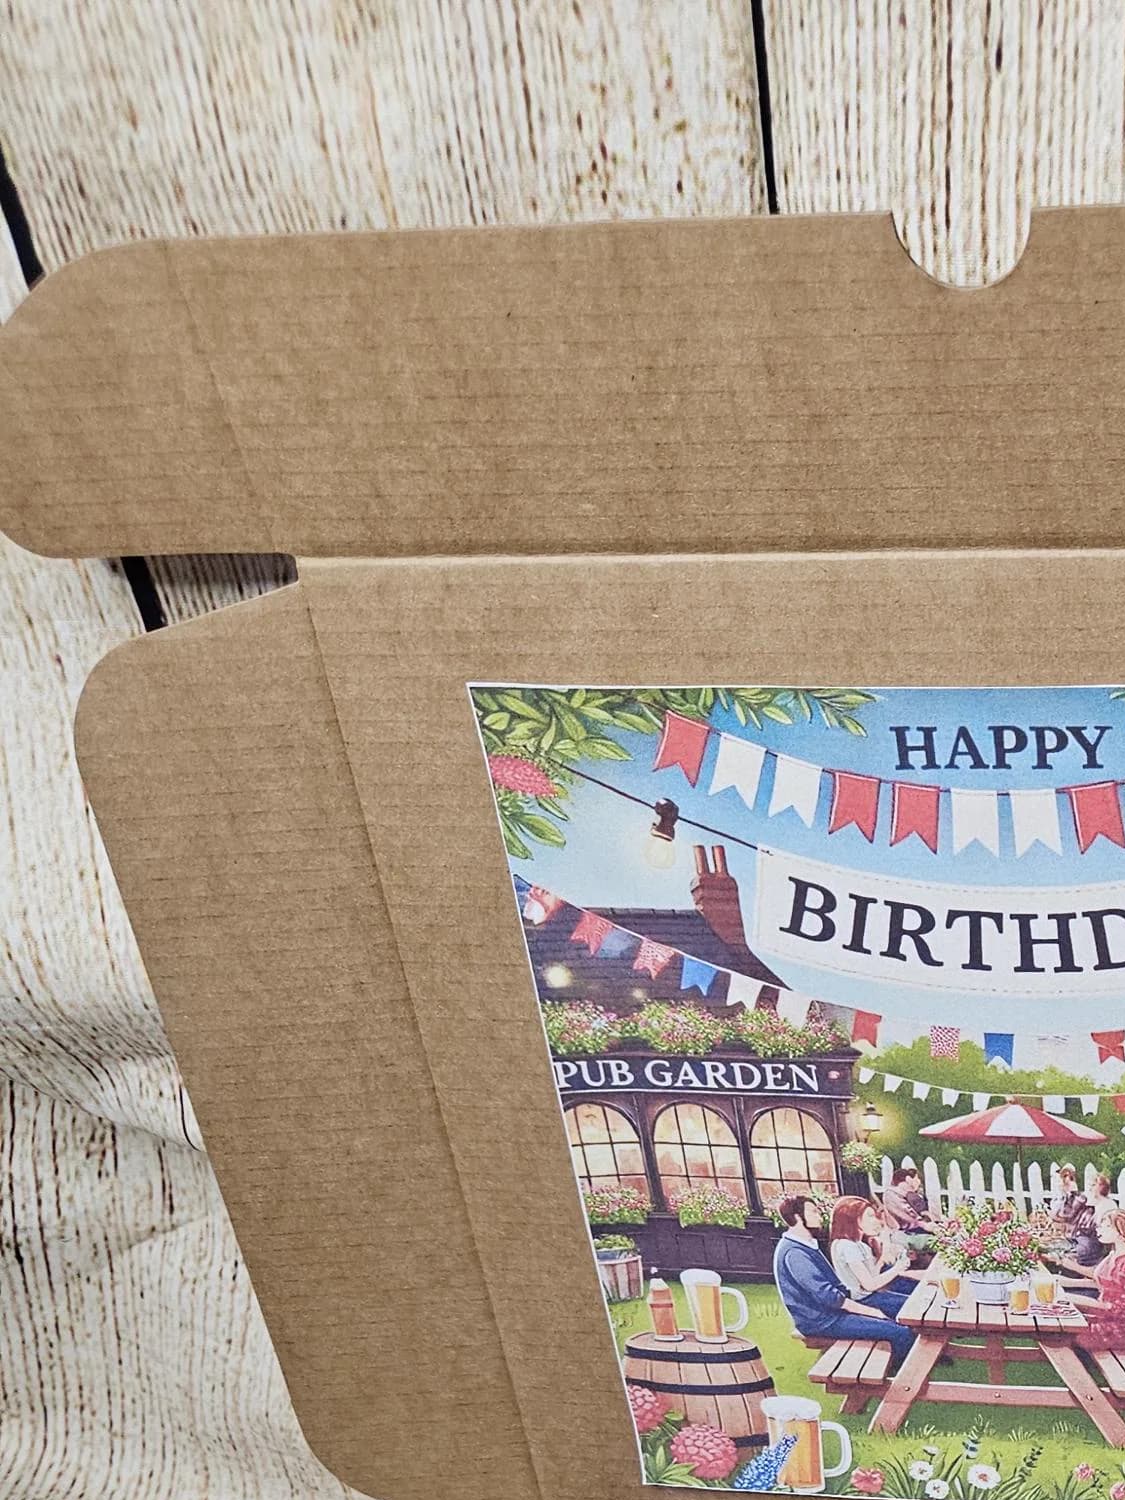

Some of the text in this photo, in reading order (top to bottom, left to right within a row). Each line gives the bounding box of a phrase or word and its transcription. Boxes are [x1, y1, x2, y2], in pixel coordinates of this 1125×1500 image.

[890, 725, 1113, 770] HAPPY
[556, 1059, 820, 1093] PUB GARDEN
